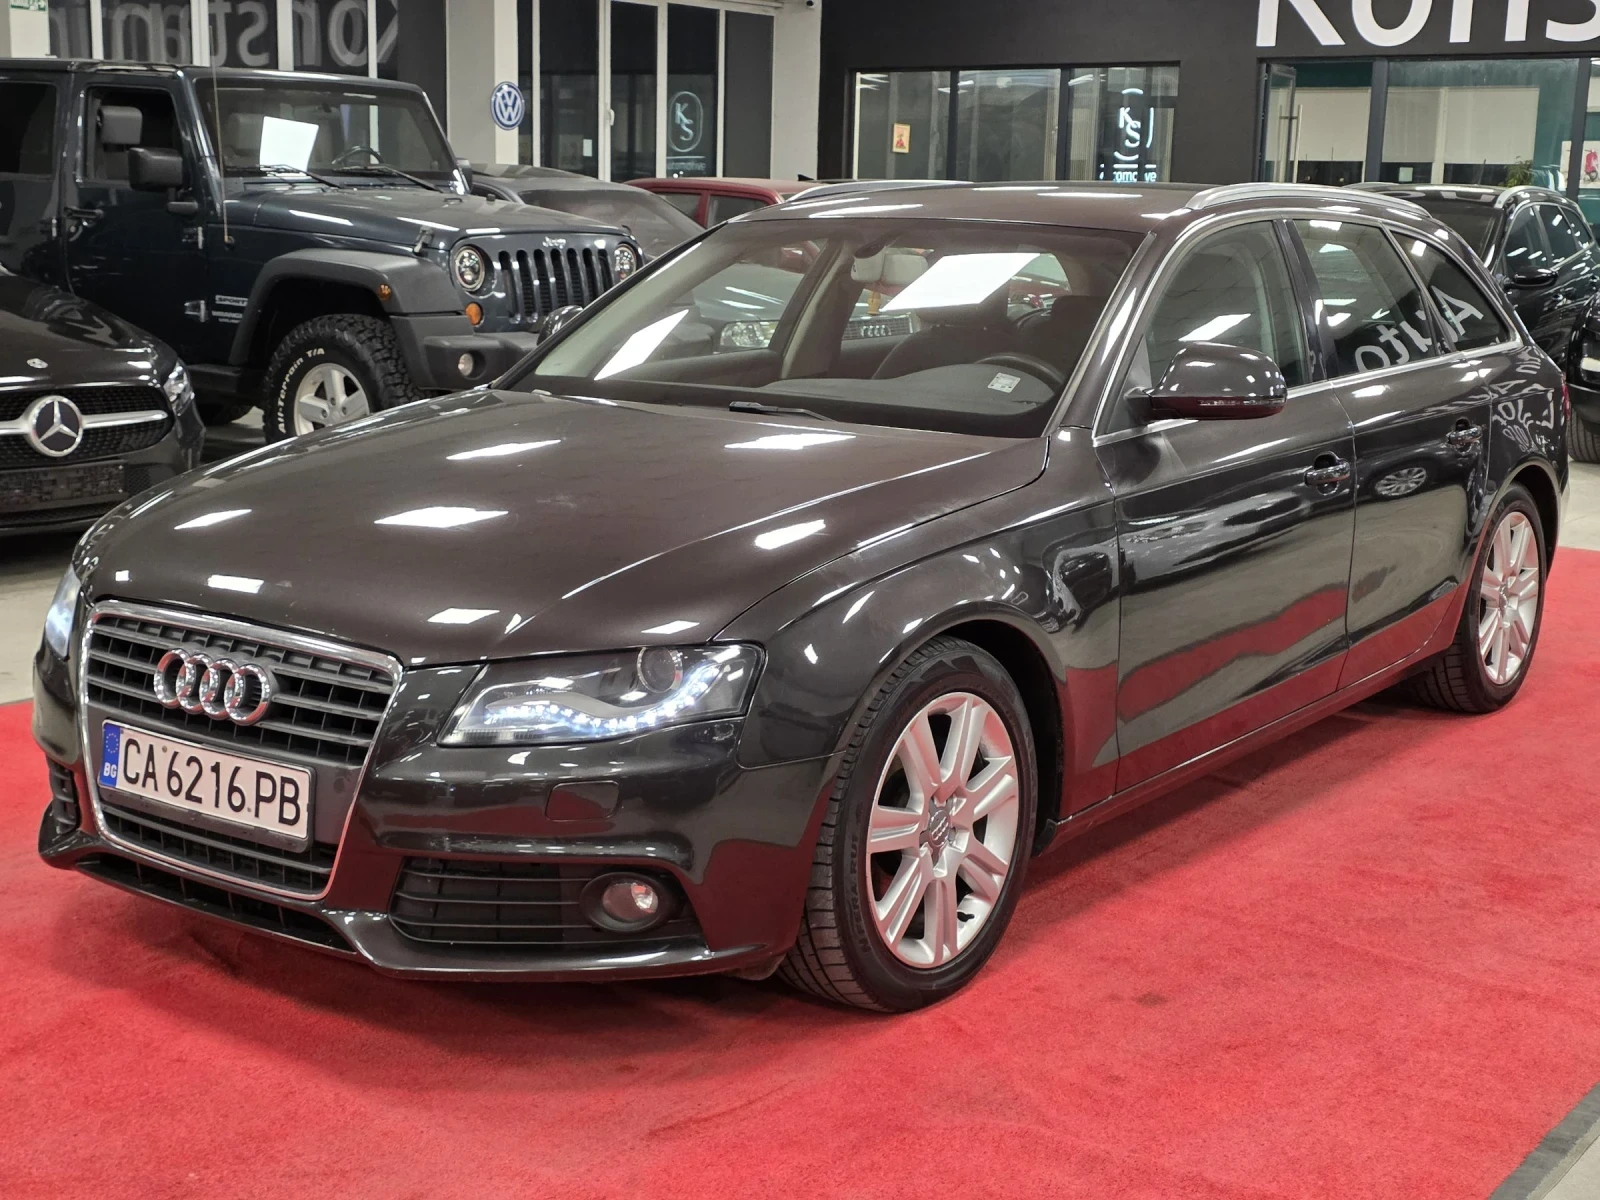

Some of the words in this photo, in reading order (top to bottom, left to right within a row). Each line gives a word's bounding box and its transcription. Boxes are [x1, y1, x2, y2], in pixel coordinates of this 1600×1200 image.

[1118, 106, 1142, 148] KS
[542, 236, 567, 249] Jeep
[216, 296, 248, 305] SPORT
[306, 347, 325, 358] T/A
[103, 762, 118, 779] BG
[122, 738, 159, 792] CA
[166, 750, 247, 813] 6216
[253, 770, 302, 826] PB
